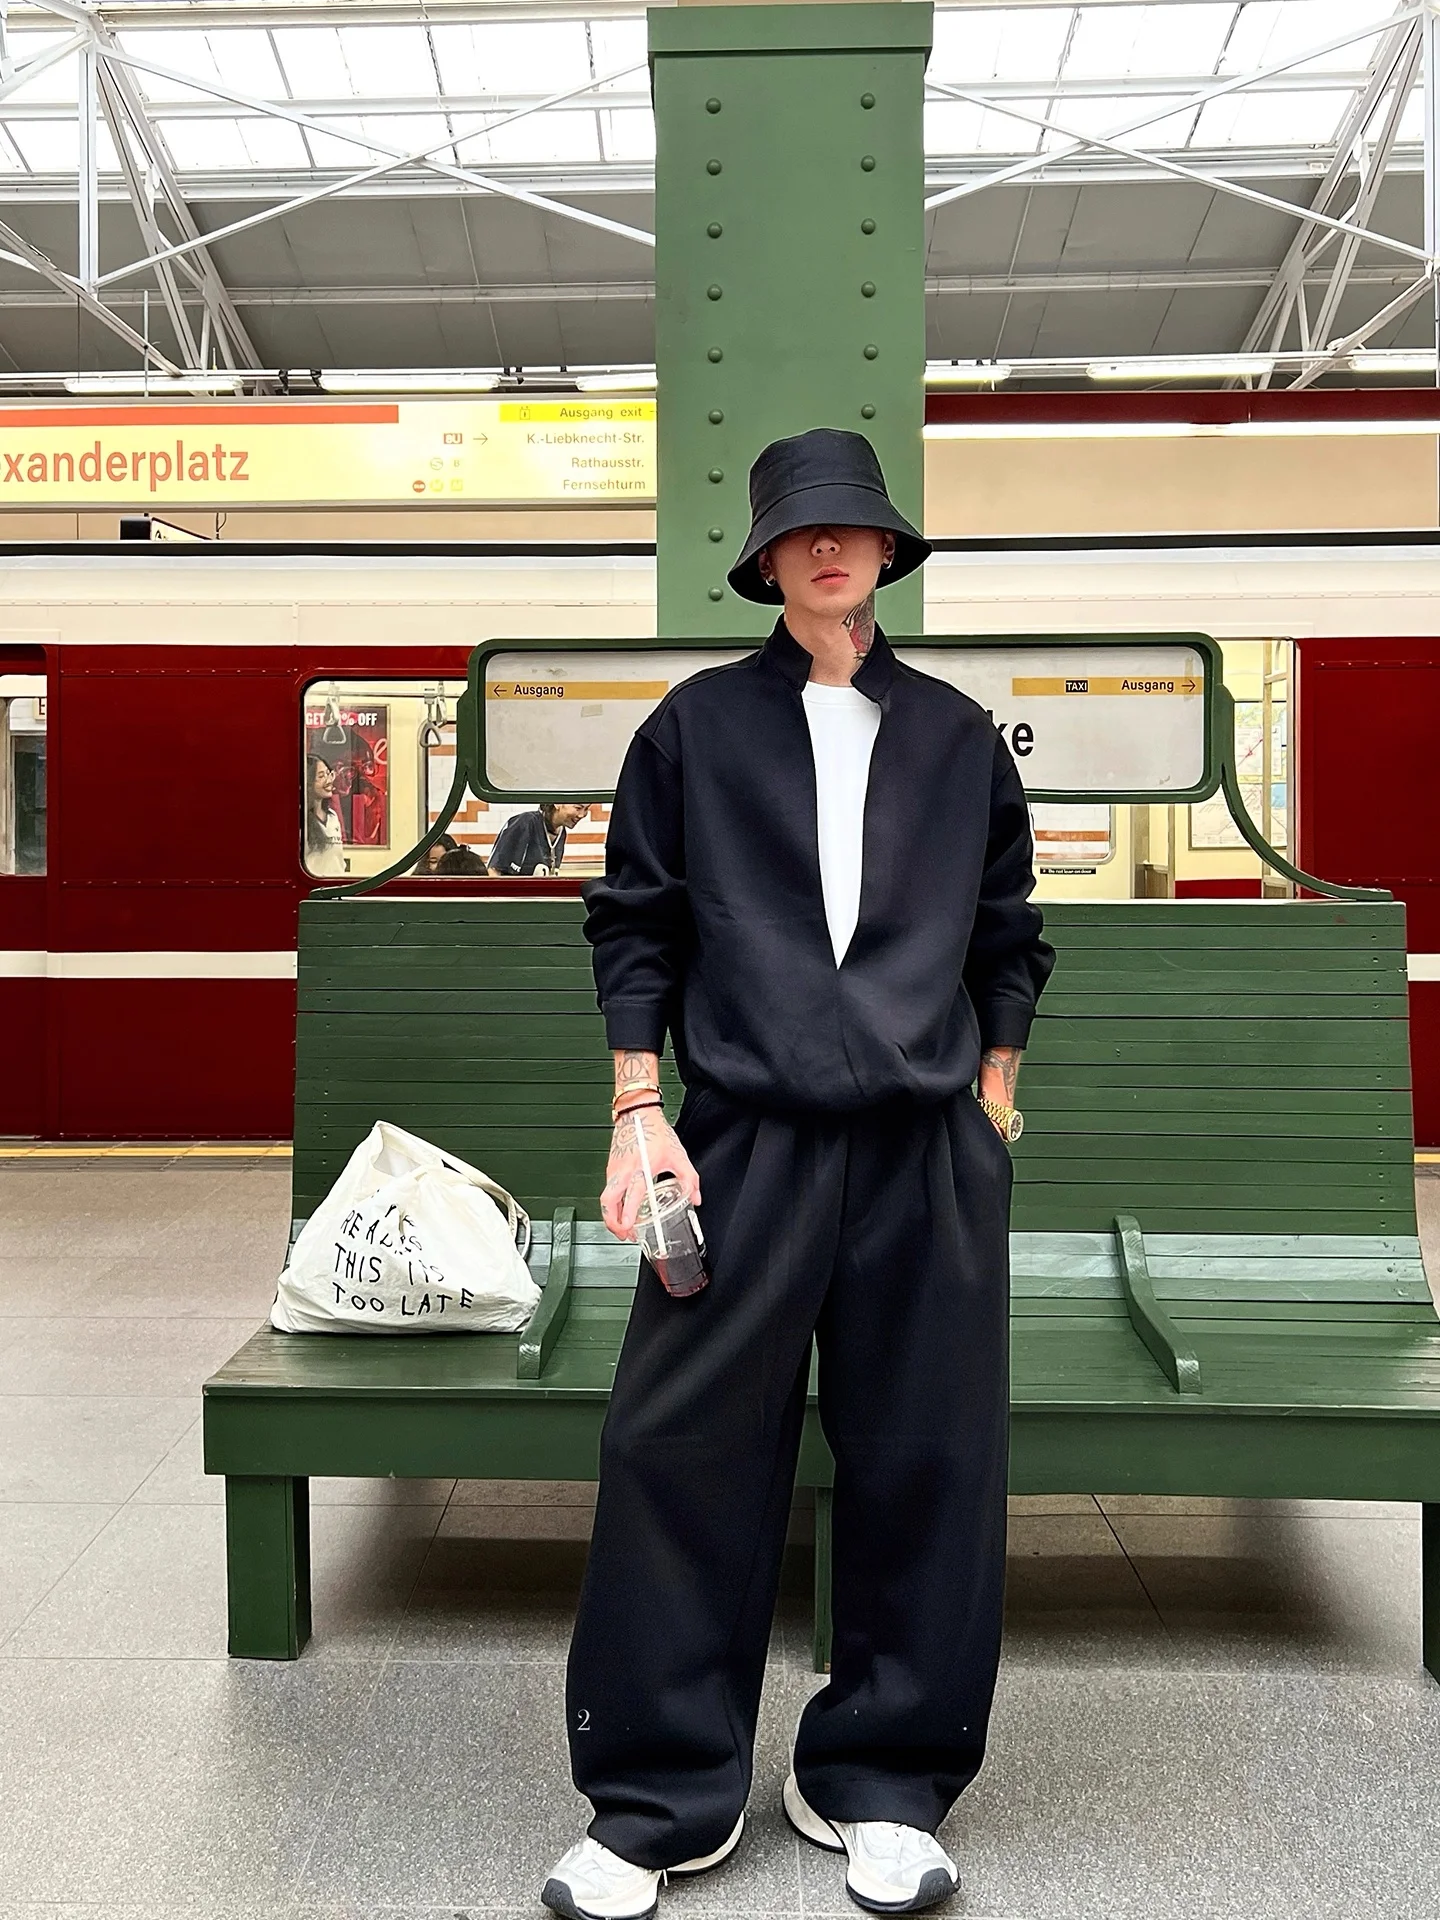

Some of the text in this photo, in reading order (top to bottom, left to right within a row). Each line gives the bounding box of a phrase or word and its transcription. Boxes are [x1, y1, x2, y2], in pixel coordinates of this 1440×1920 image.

[559, 406, 642, 420] Ausgang exit
[526, 432, 645, 445] K.-Liebknecht-Str.
[0, 439, 249, 492] xanderplatz
[571, 457, 645, 469] Rathausstr.
[562, 479, 646, 490] Fernsehturm
[513, 684, 564, 698] Ausgang
[1066, 681, 1088, 692] TAXI
[1121, 679, 1174, 692] Ausgang
[305, 712, 326, 726] GET
[357, 712, 378, 726] OFF
[334, 1242, 382, 1283] THIS
[332, 1281, 475, 1316] TOO LATE
